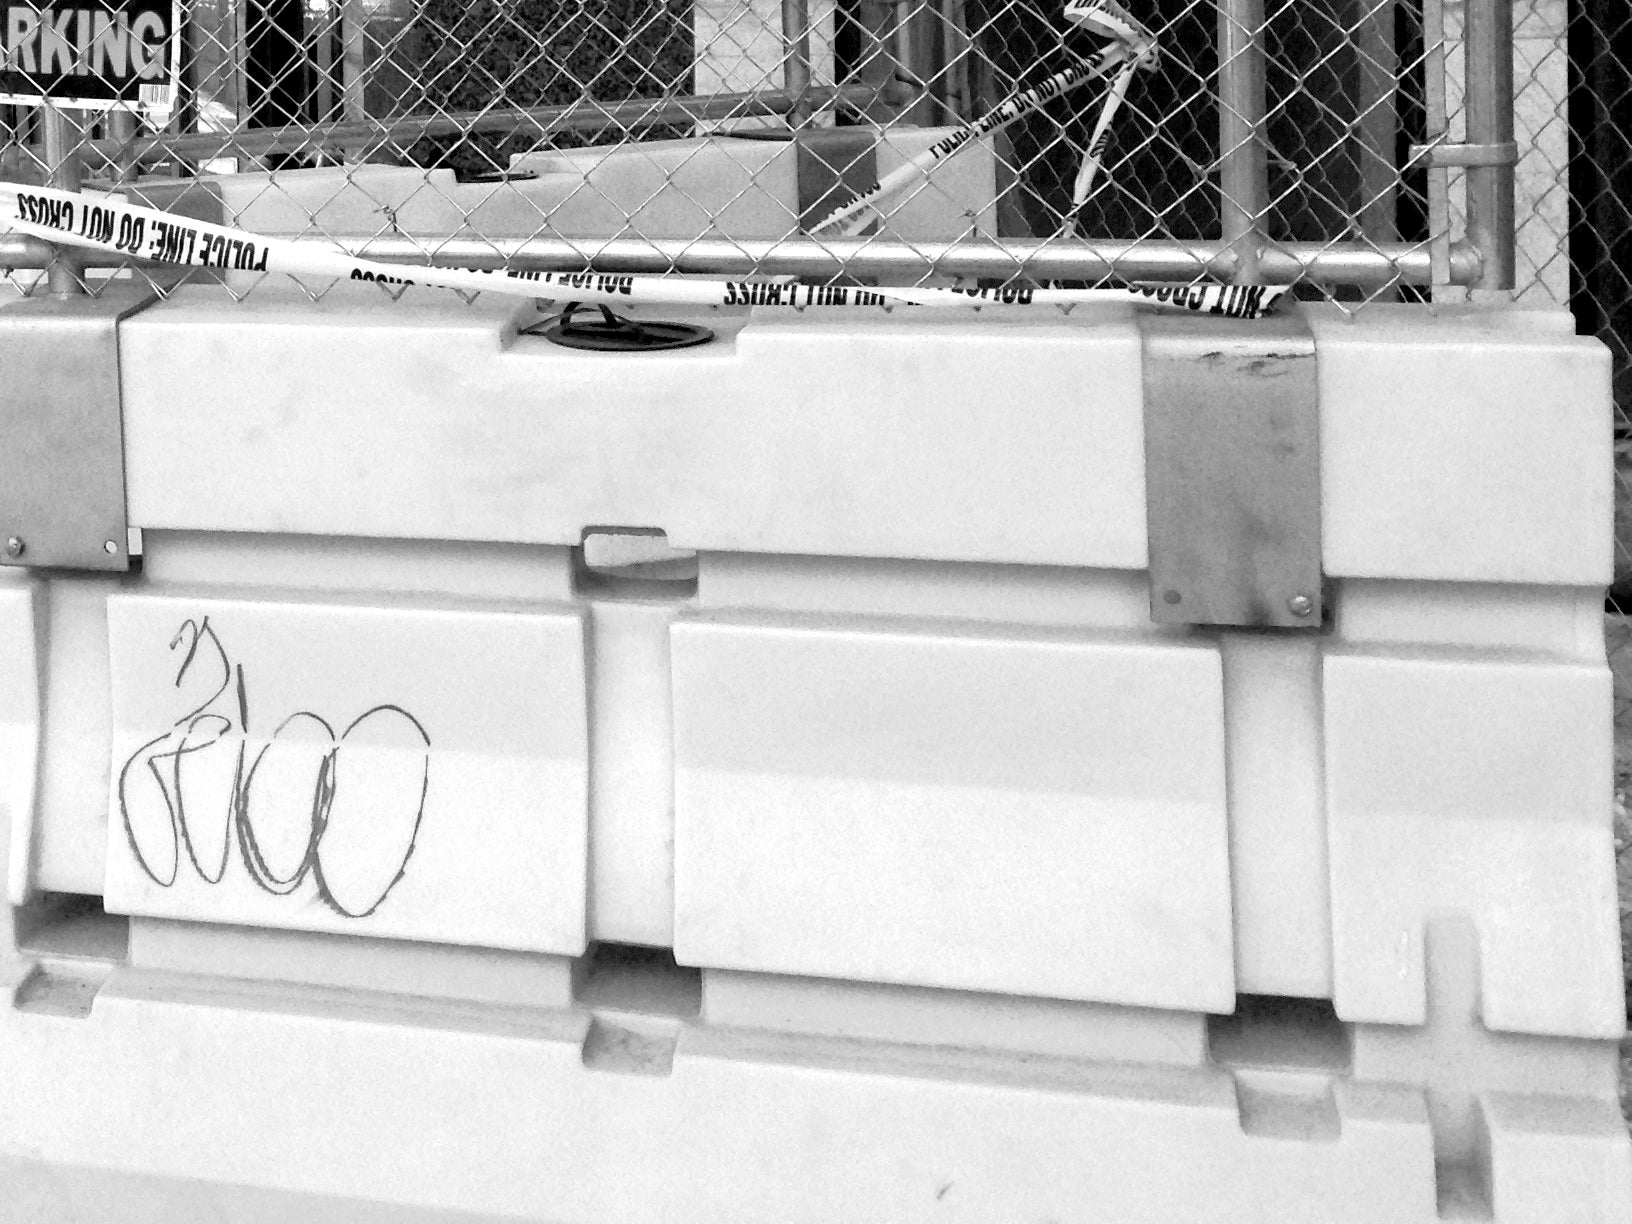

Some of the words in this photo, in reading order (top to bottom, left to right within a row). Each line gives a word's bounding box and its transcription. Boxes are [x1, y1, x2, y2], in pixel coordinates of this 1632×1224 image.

[14, 193, 74, 232] CROSS
[74, 205, 116, 244] NOT
[115, 213, 146, 255] DO
[198, 232, 268, 272] POLICE
